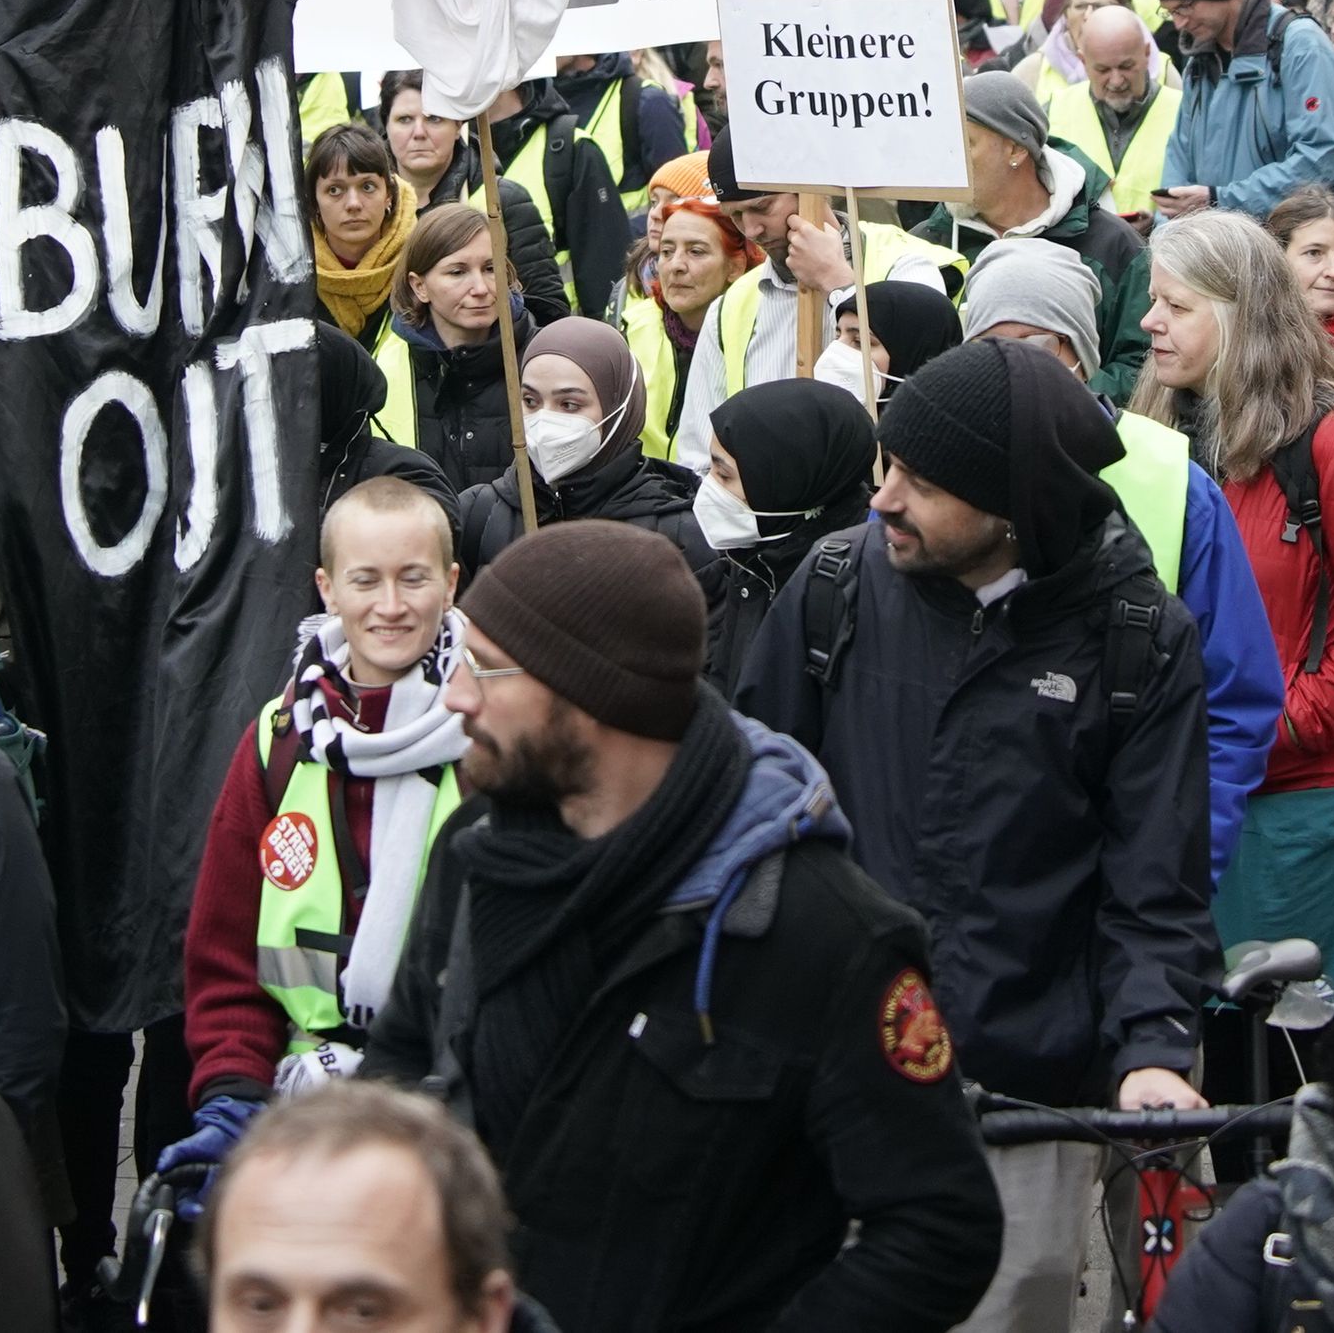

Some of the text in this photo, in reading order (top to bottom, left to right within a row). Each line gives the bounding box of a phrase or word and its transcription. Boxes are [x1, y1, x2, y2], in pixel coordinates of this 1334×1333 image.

[760, 22, 916, 59] Kleinere
[754, 80, 933, 128] Gruppen!
[60, 316, 318, 578] OUT
[267, 828, 306, 882] BEREIT
[275, 816, 314, 871] STREIK-
